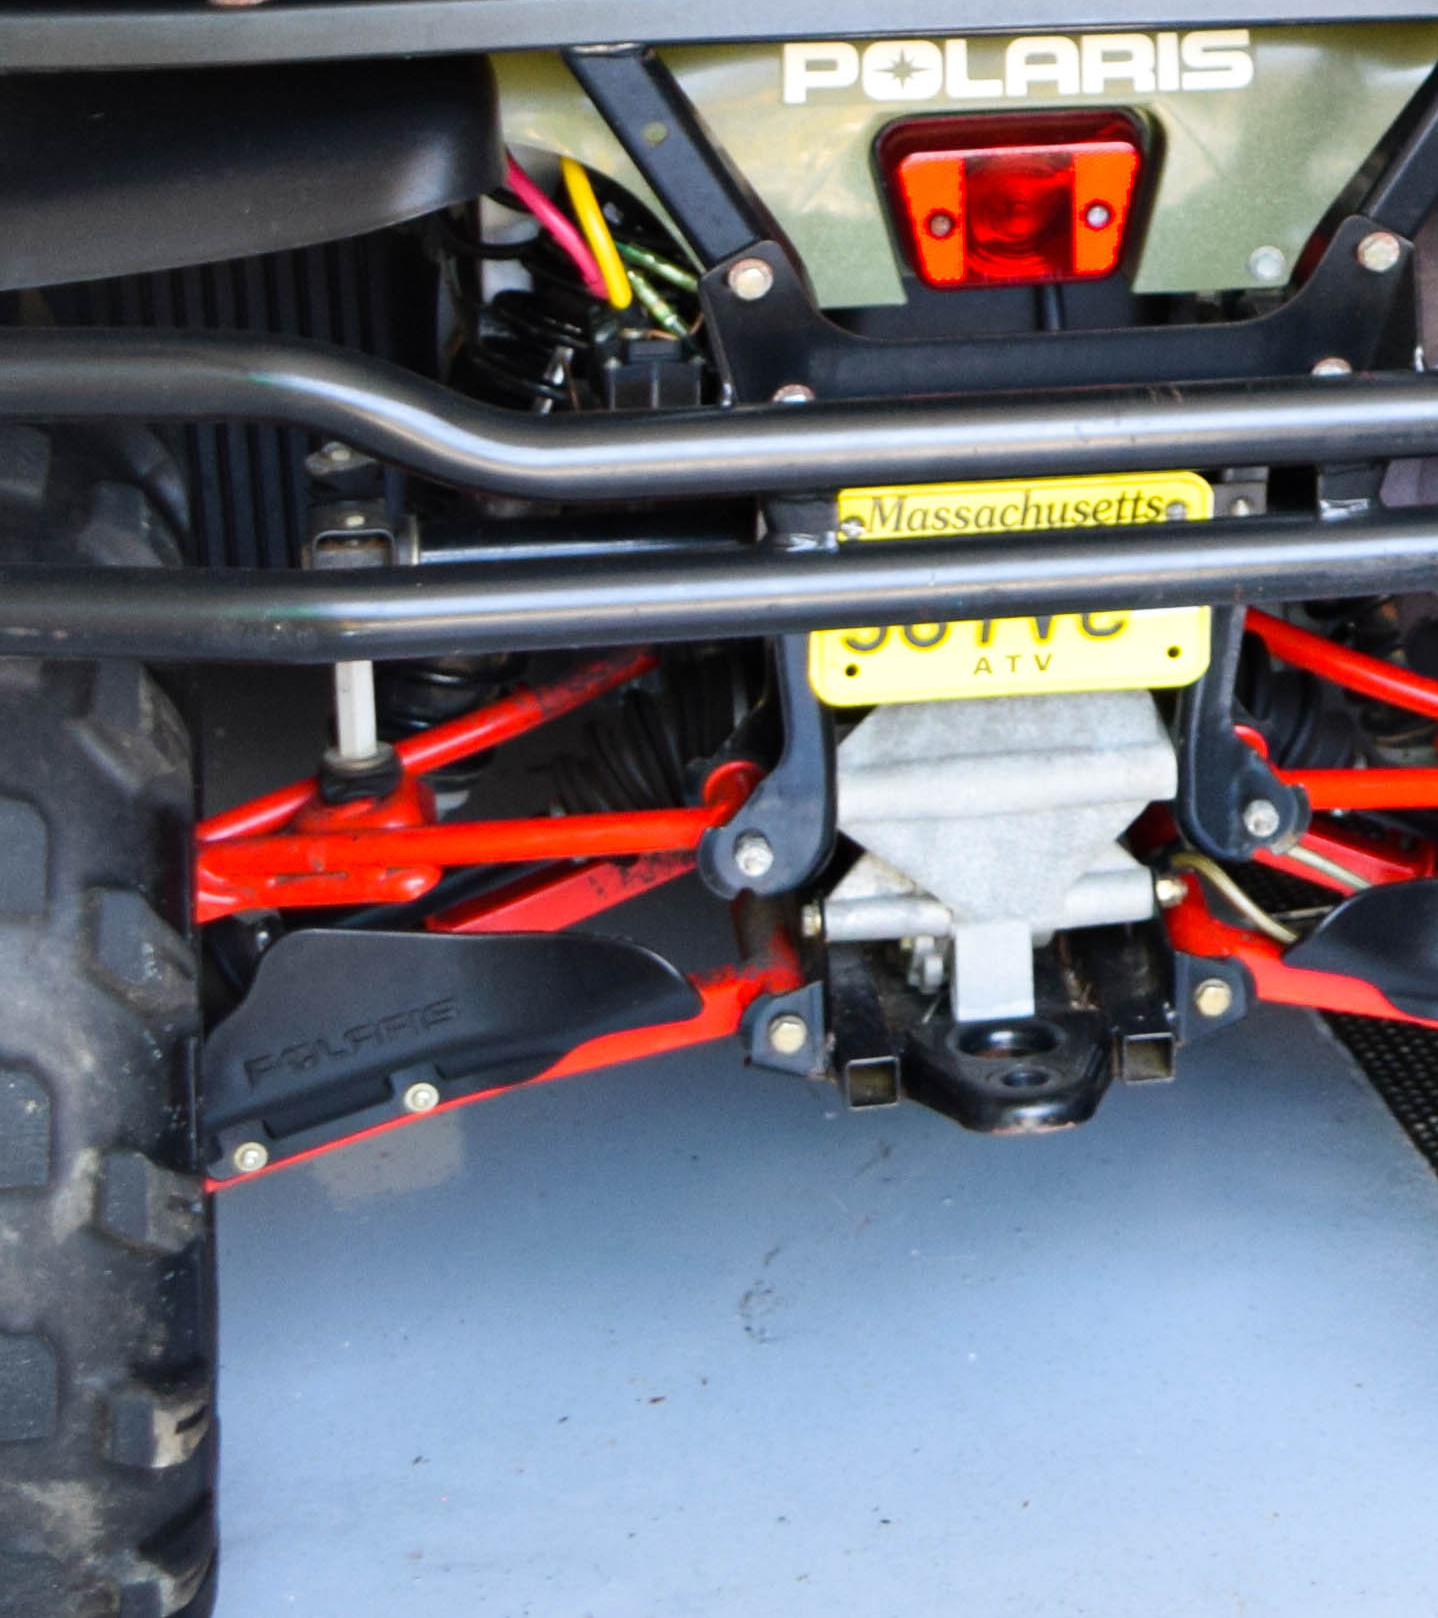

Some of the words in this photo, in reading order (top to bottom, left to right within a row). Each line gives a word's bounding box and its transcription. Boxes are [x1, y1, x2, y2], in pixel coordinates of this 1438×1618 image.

[782, 30, 1256, 105] POLARIS
[867, 488, 1165, 534] Massachusetts
[973, 653, 1052, 676] ATV
[244, 995, 462, 1084] POLARIS
